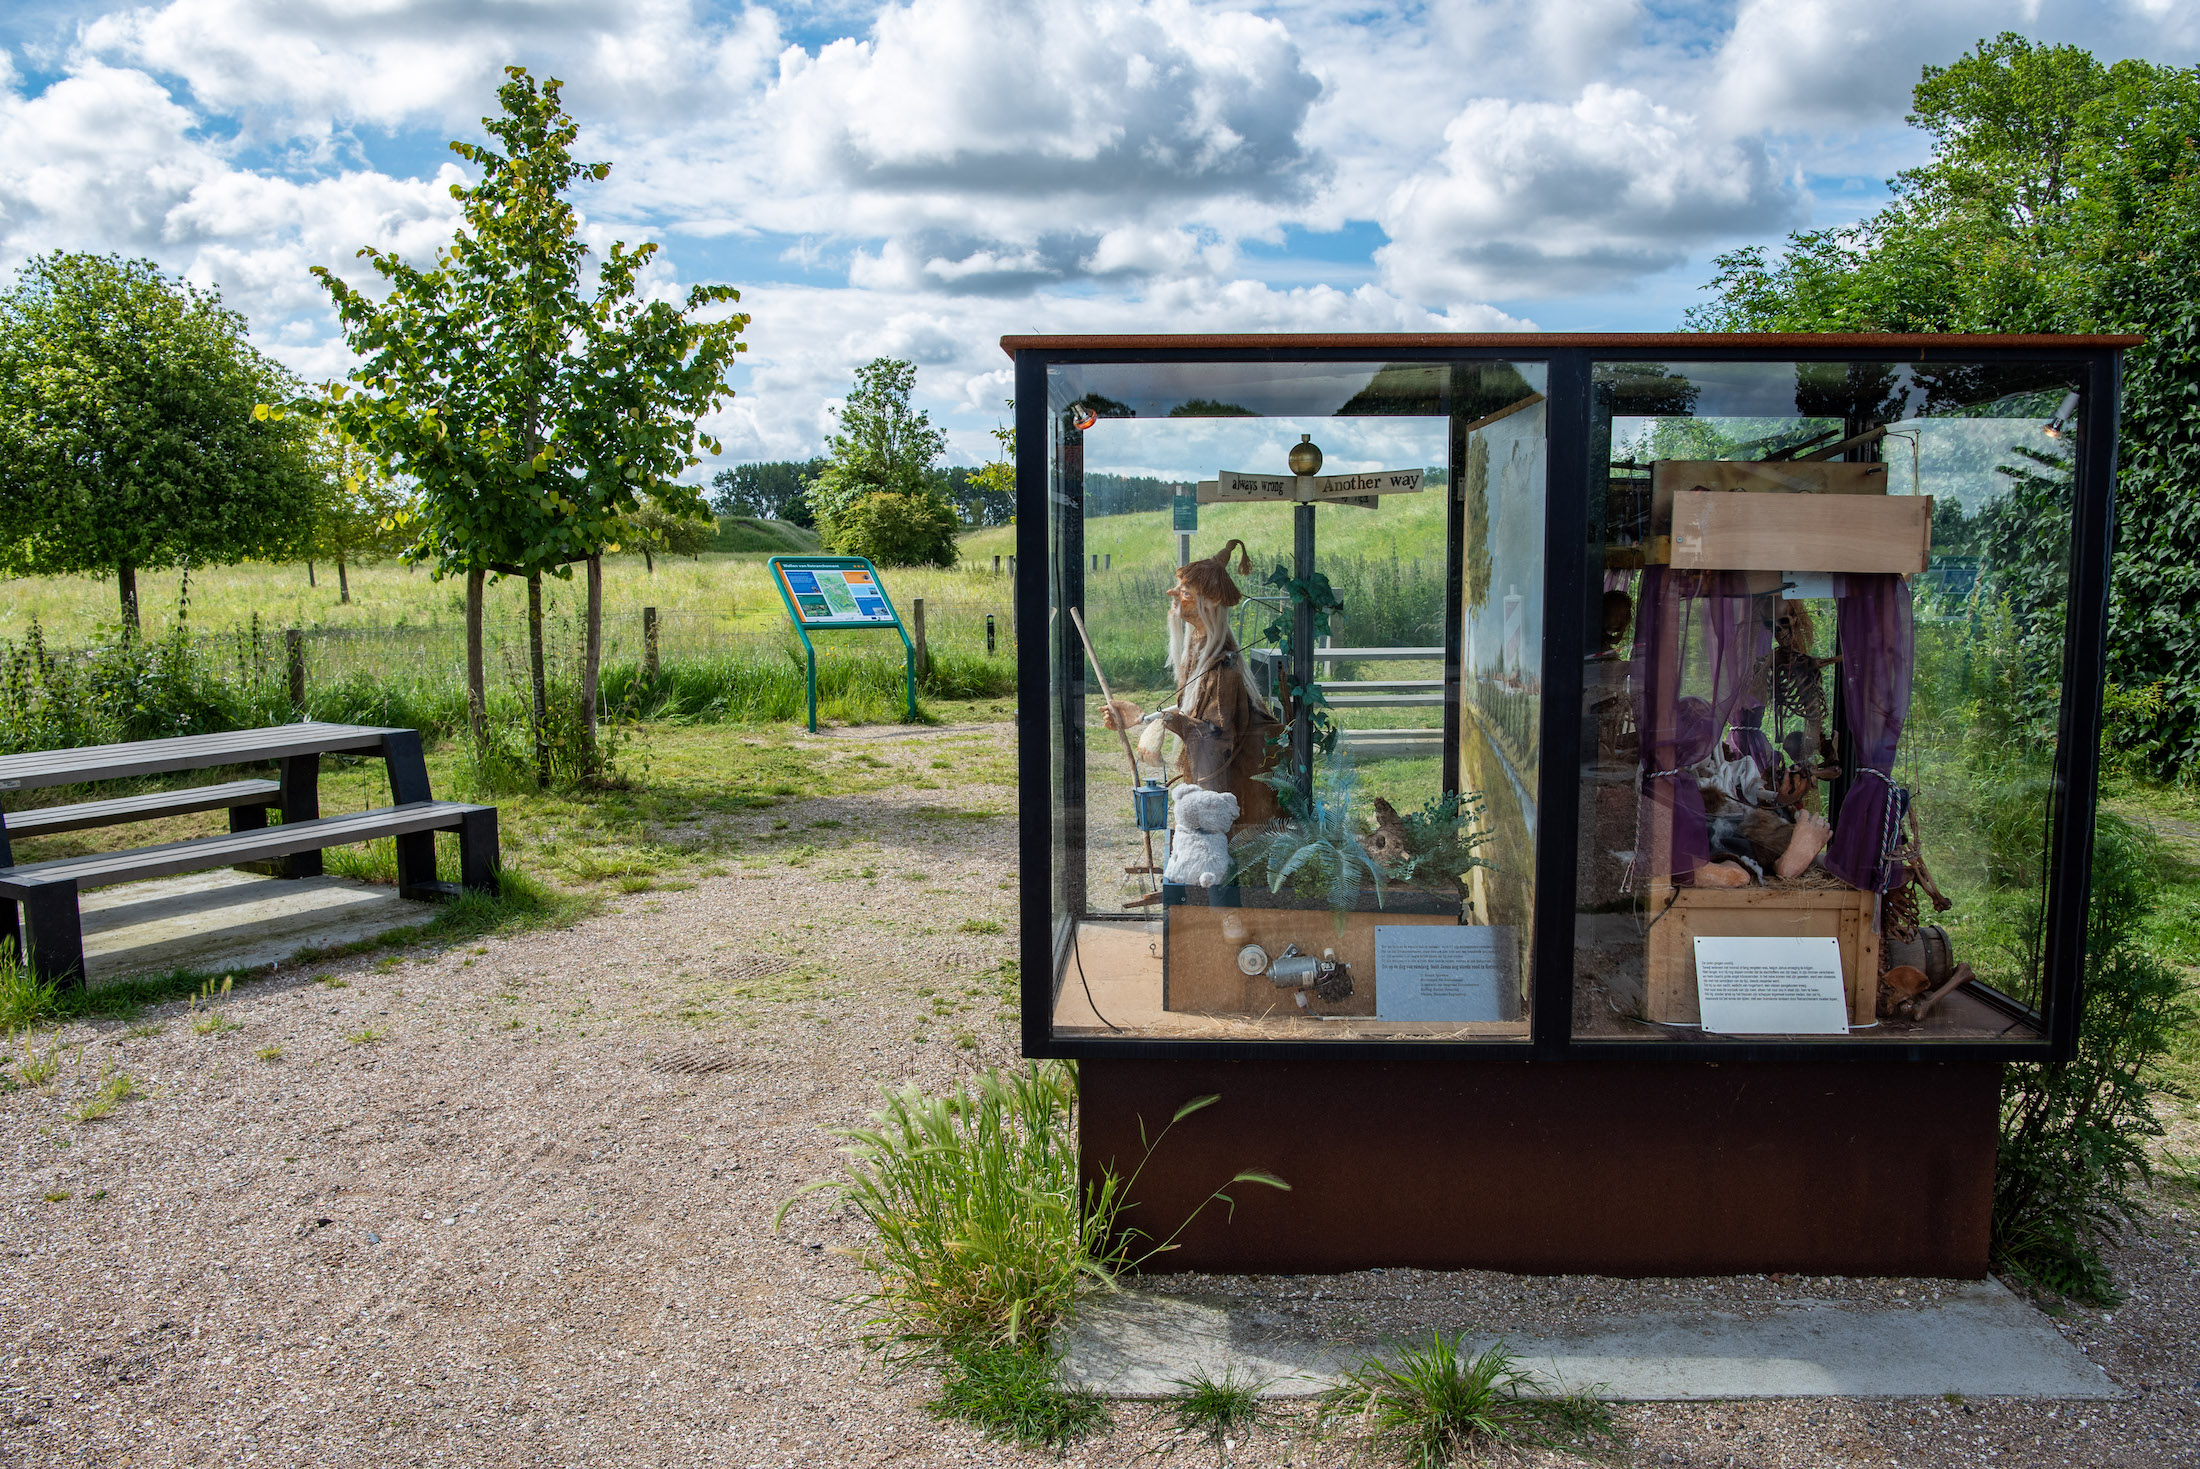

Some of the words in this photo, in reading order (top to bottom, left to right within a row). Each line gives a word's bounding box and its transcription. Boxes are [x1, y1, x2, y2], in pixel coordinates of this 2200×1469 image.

[1232, 475, 1258, 495] always
[1261, 480, 1285, 496] wrong
[1322, 475, 1381, 493] Another
[1389, 474, 1420, 490] way
